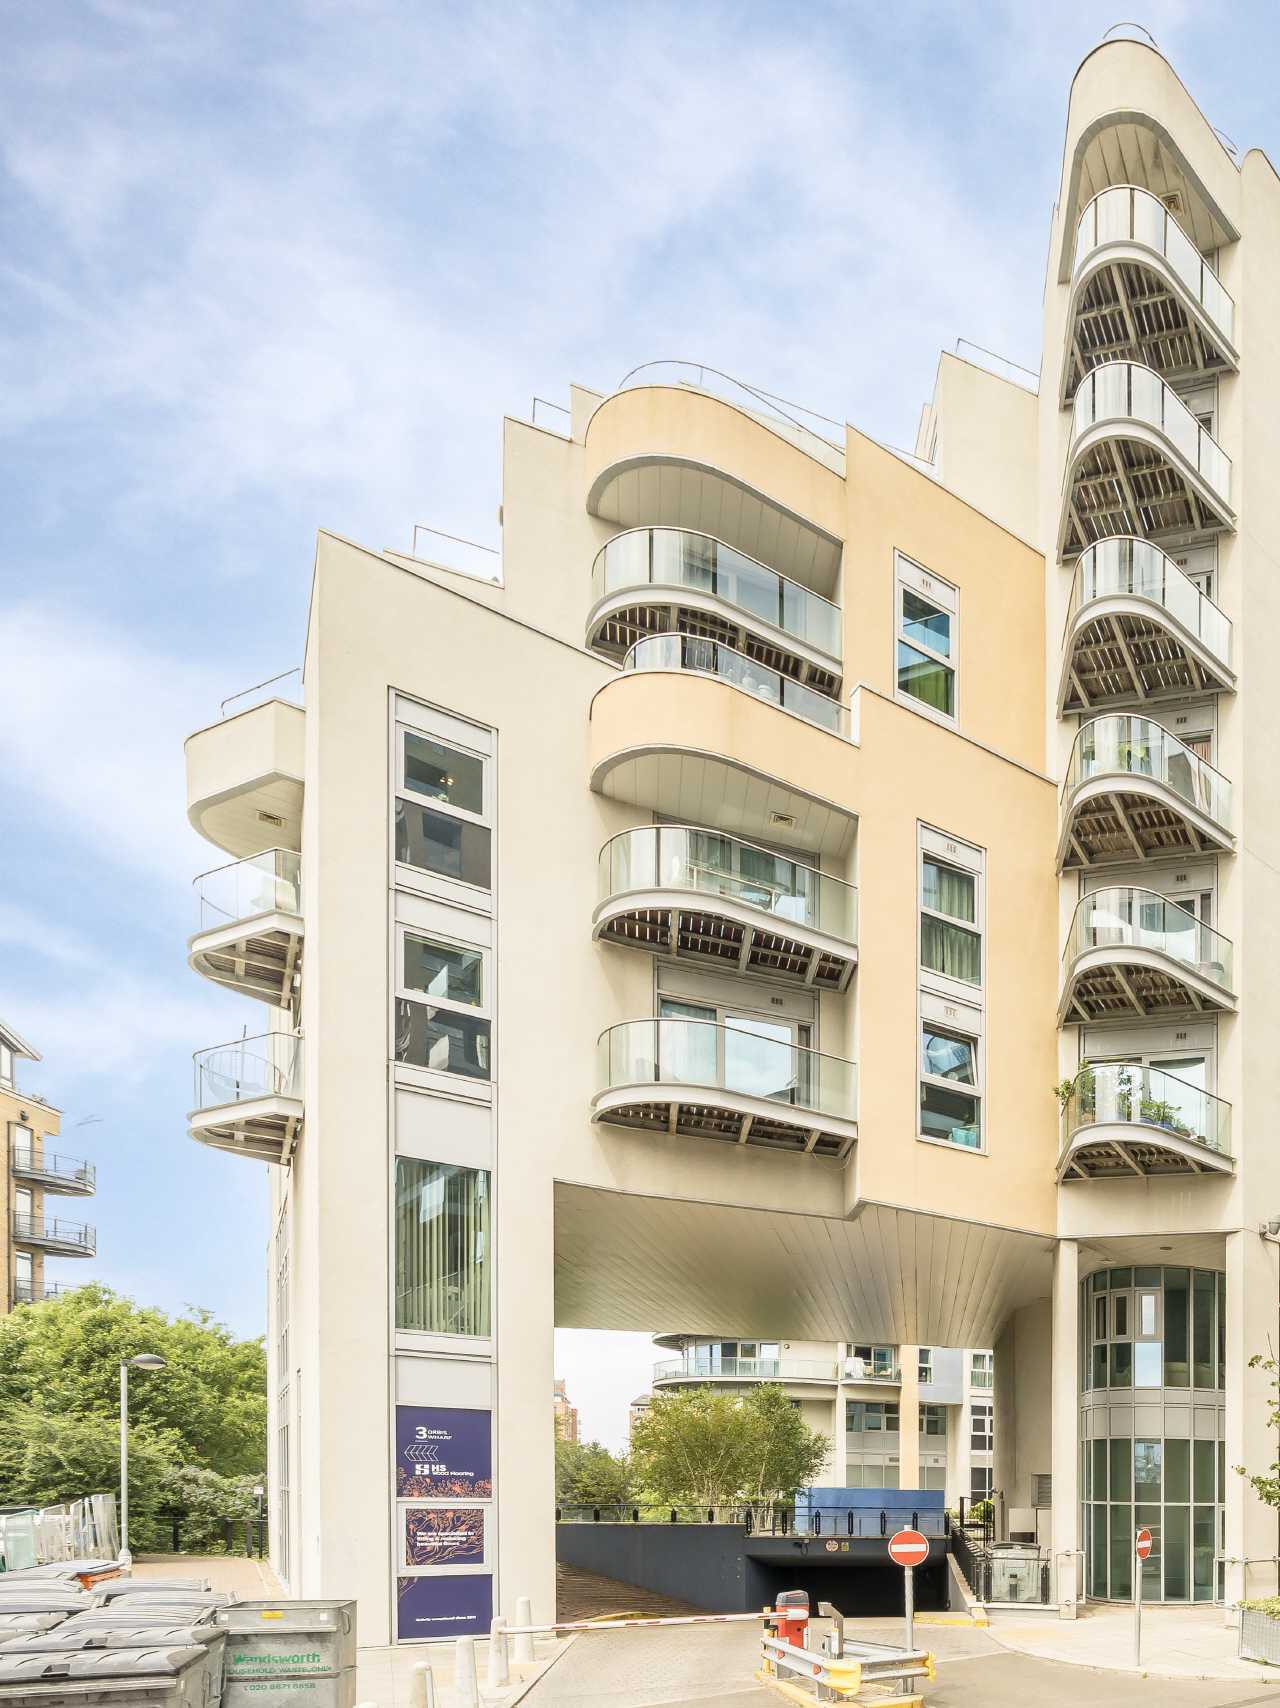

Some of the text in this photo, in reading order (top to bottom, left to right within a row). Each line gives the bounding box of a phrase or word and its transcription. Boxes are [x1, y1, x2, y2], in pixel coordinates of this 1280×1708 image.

[415, 1426, 428, 1440] 3
[431, 1463, 447, 1472] HS
[233, 1652, 320, 1664] Wandsworth
